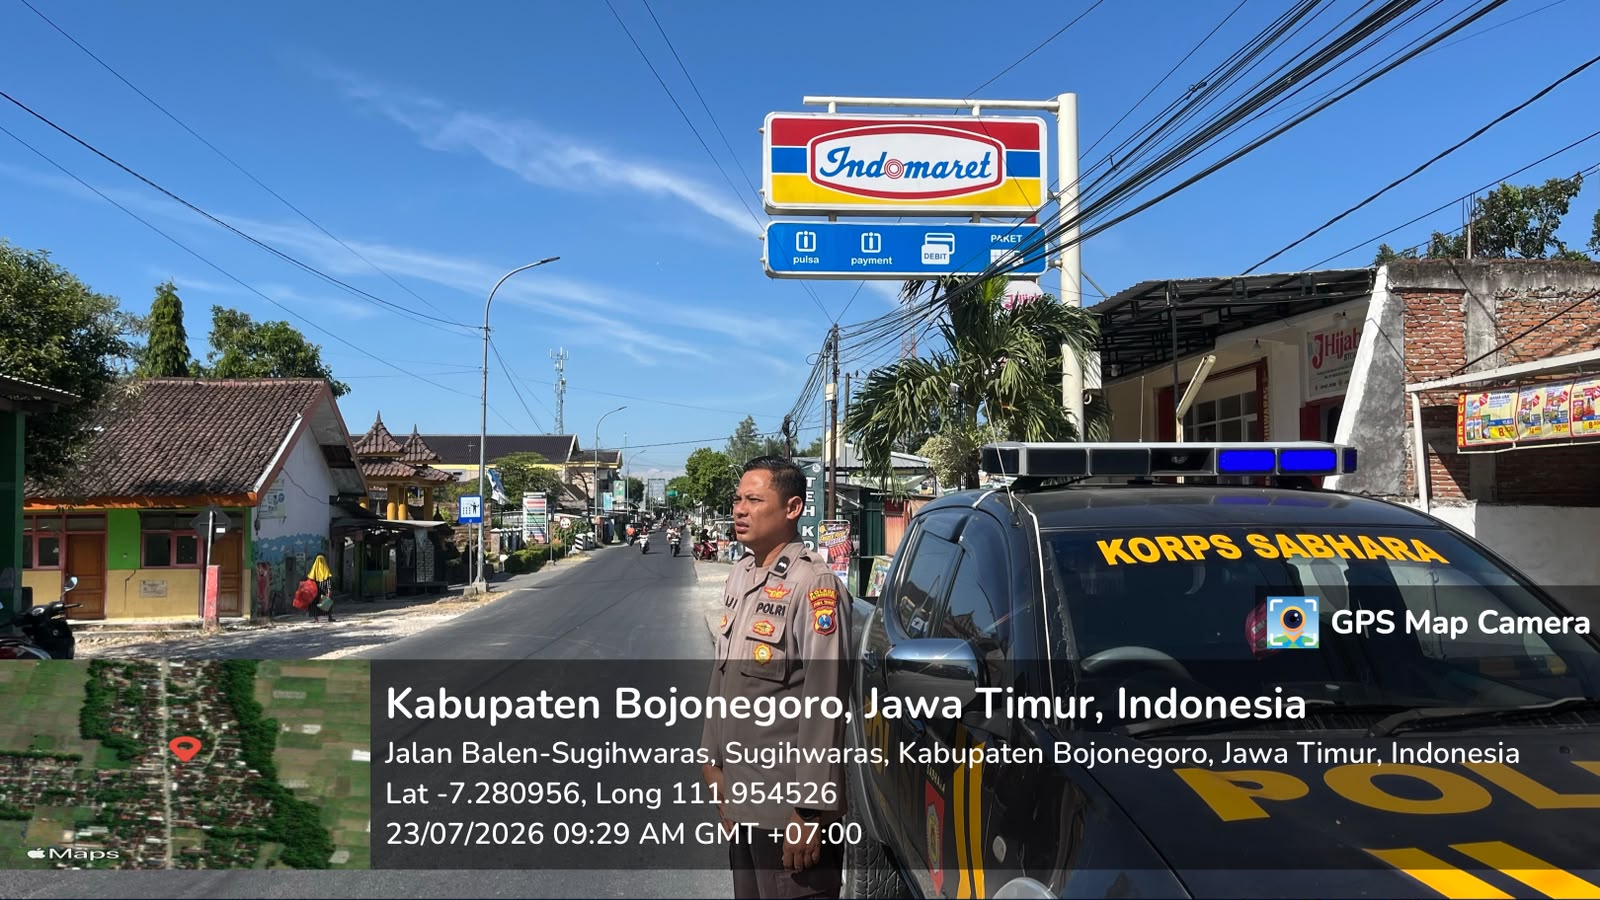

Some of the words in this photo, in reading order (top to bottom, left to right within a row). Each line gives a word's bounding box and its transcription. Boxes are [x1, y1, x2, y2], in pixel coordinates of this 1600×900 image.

[819, 145, 992, 180] Indomaret
[990, 234, 1022, 243] PAKET
[793, 255, 819, 265] pulsa
[851, 256, 892, 266] payment
[923, 252, 947, 261] DEBIT
[1457, 393, 1465, 446] SUPER
[802, 476, 816, 517] TEH
[1096, 533, 1243, 566] KORPS
[1253, 533, 1450, 565] SABHARA
[755, 602, 786, 616] POLRI
[1173, 762, 1600, 821] POL
